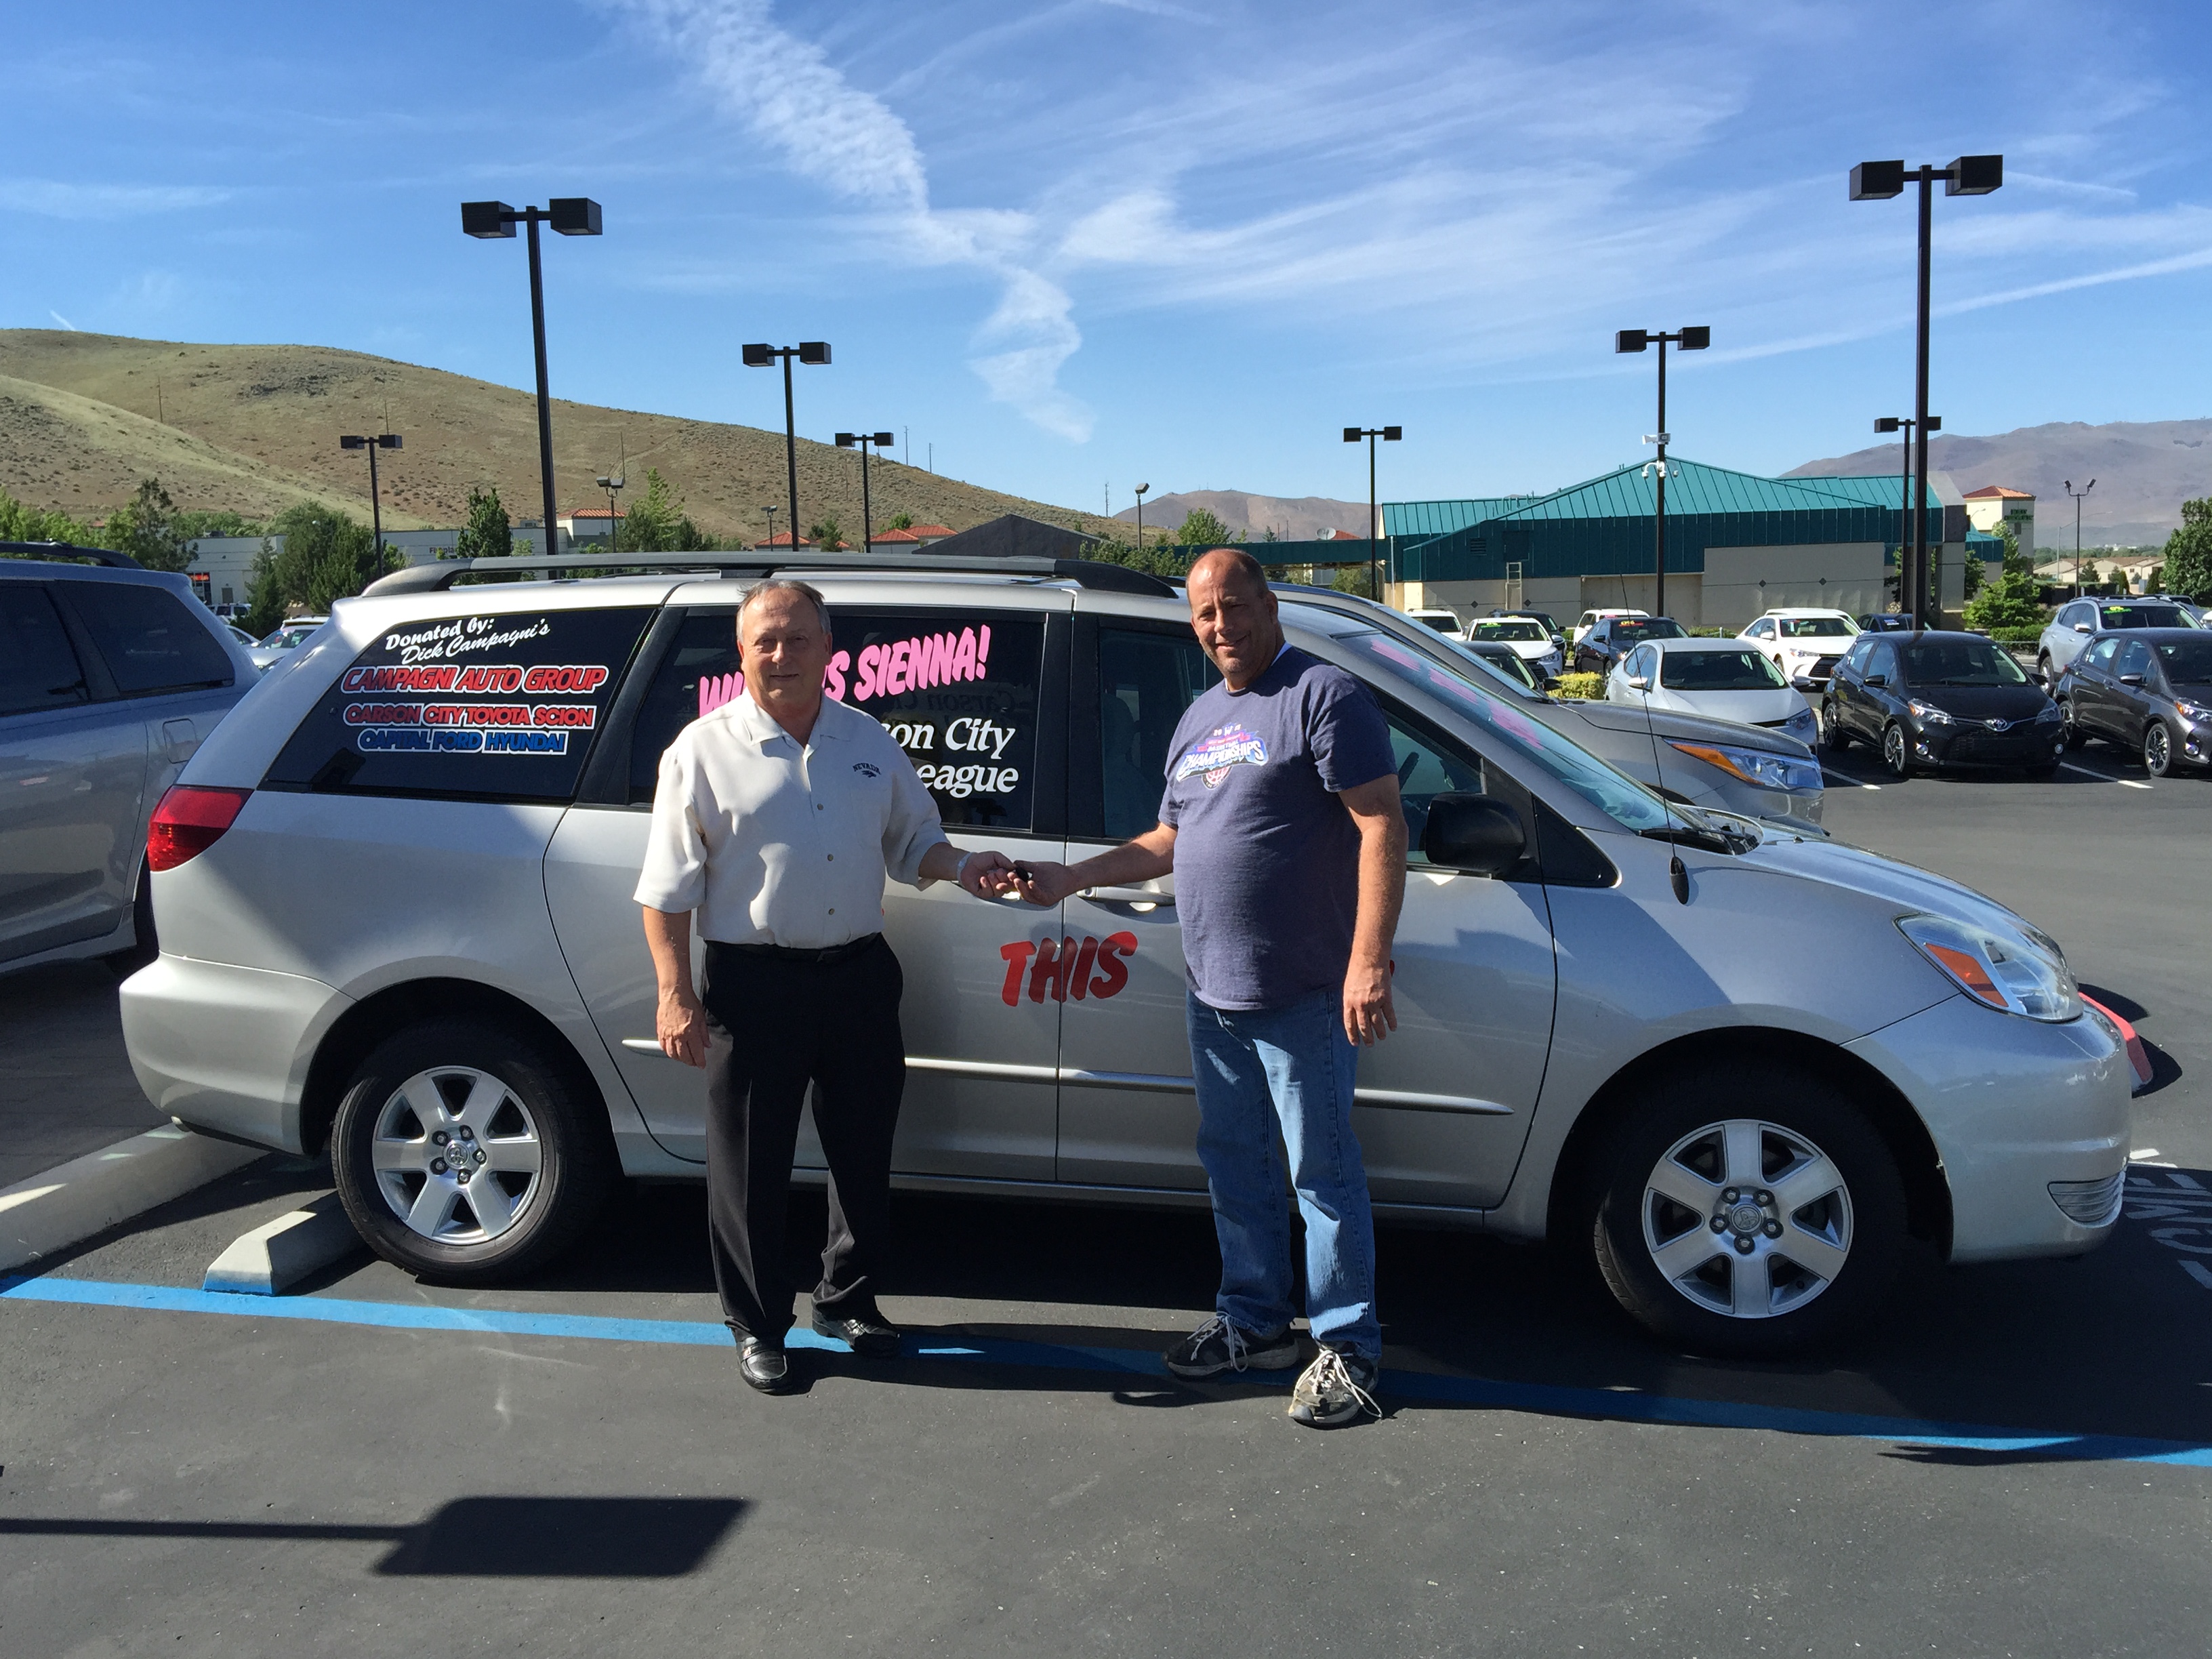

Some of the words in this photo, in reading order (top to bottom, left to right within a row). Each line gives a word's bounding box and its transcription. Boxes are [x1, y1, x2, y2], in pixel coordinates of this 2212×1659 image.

[385, 619, 463, 651] Donated
[467, 617, 494, 635] by:
[401, 640, 444, 665] Dick
[445, 618, 550, 657] Campagni's
[342, 666, 459, 692] CAMPAGNI
[455, 666, 523, 692] AUTO
[523, 666, 608, 692] GROUP
[699, 671, 747, 718] WI
[854, 624, 991, 701] SIENNA!
[344, 704, 422, 724] CARSON
[422, 704, 465, 725] CITY
[466, 705, 532, 726] TOYOTA
[533, 707, 595, 727] SCION
[360, 729, 431, 750] CAPITAL
[433, 731, 484, 751] FORD
[484, 731, 567, 753] HYUNDAI
[945, 717, 1016, 760] City
[853, 762, 881, 775] NEVADA
[1178, 740, 1265, 778] CHAMPIONSHIPS
[916, 764, 1019, 798] eague
[1000, 930, 1139, 1007] THIS
